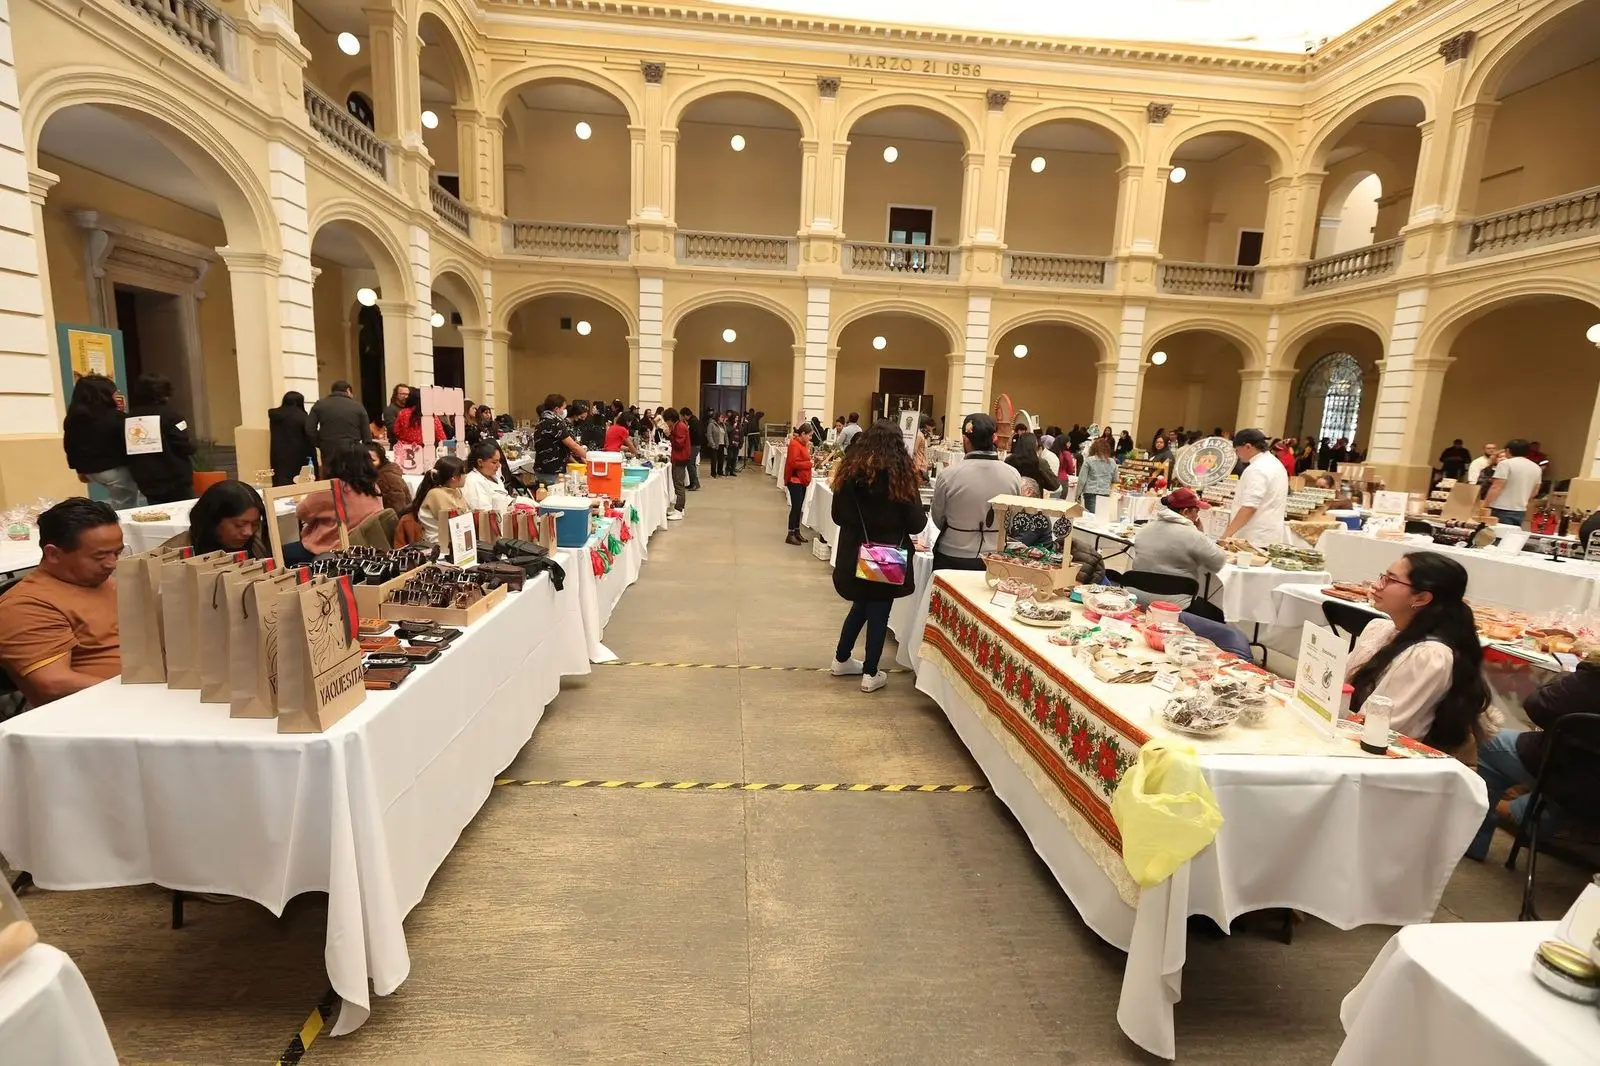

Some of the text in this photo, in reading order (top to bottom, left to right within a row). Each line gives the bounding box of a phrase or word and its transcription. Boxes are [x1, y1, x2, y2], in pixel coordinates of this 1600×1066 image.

[848, 54, 982, 77] MARZO 21 1956
[320, 666, 364, 706] YAQUESITA
